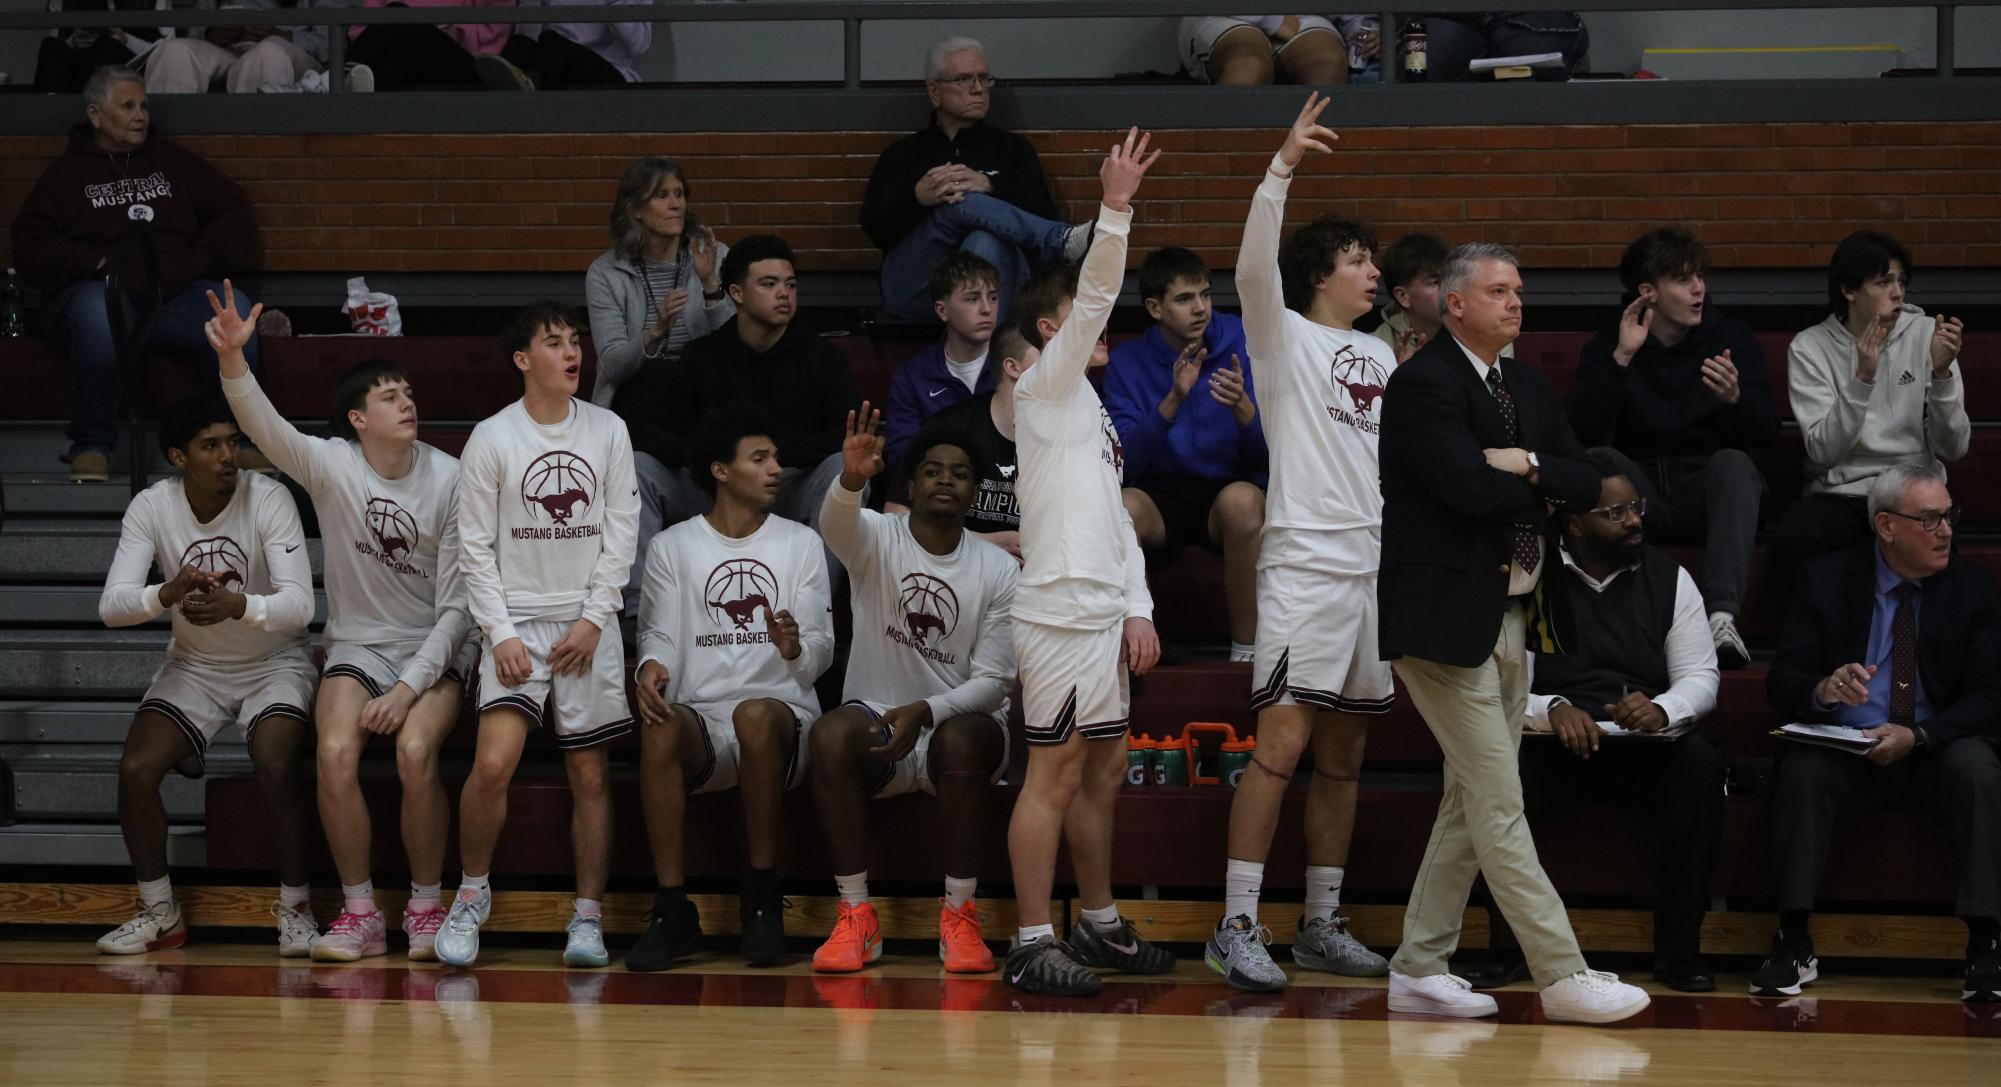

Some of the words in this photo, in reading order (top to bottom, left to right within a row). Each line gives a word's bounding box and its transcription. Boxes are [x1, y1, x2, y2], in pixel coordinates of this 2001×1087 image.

[85, 172, 165, 198] CENTRA
[511, 527, 552, 540] MUSTANG
[554, 523, 602, 540] BASKETBALL
[696, 632, 733, 647] MUSTANG
